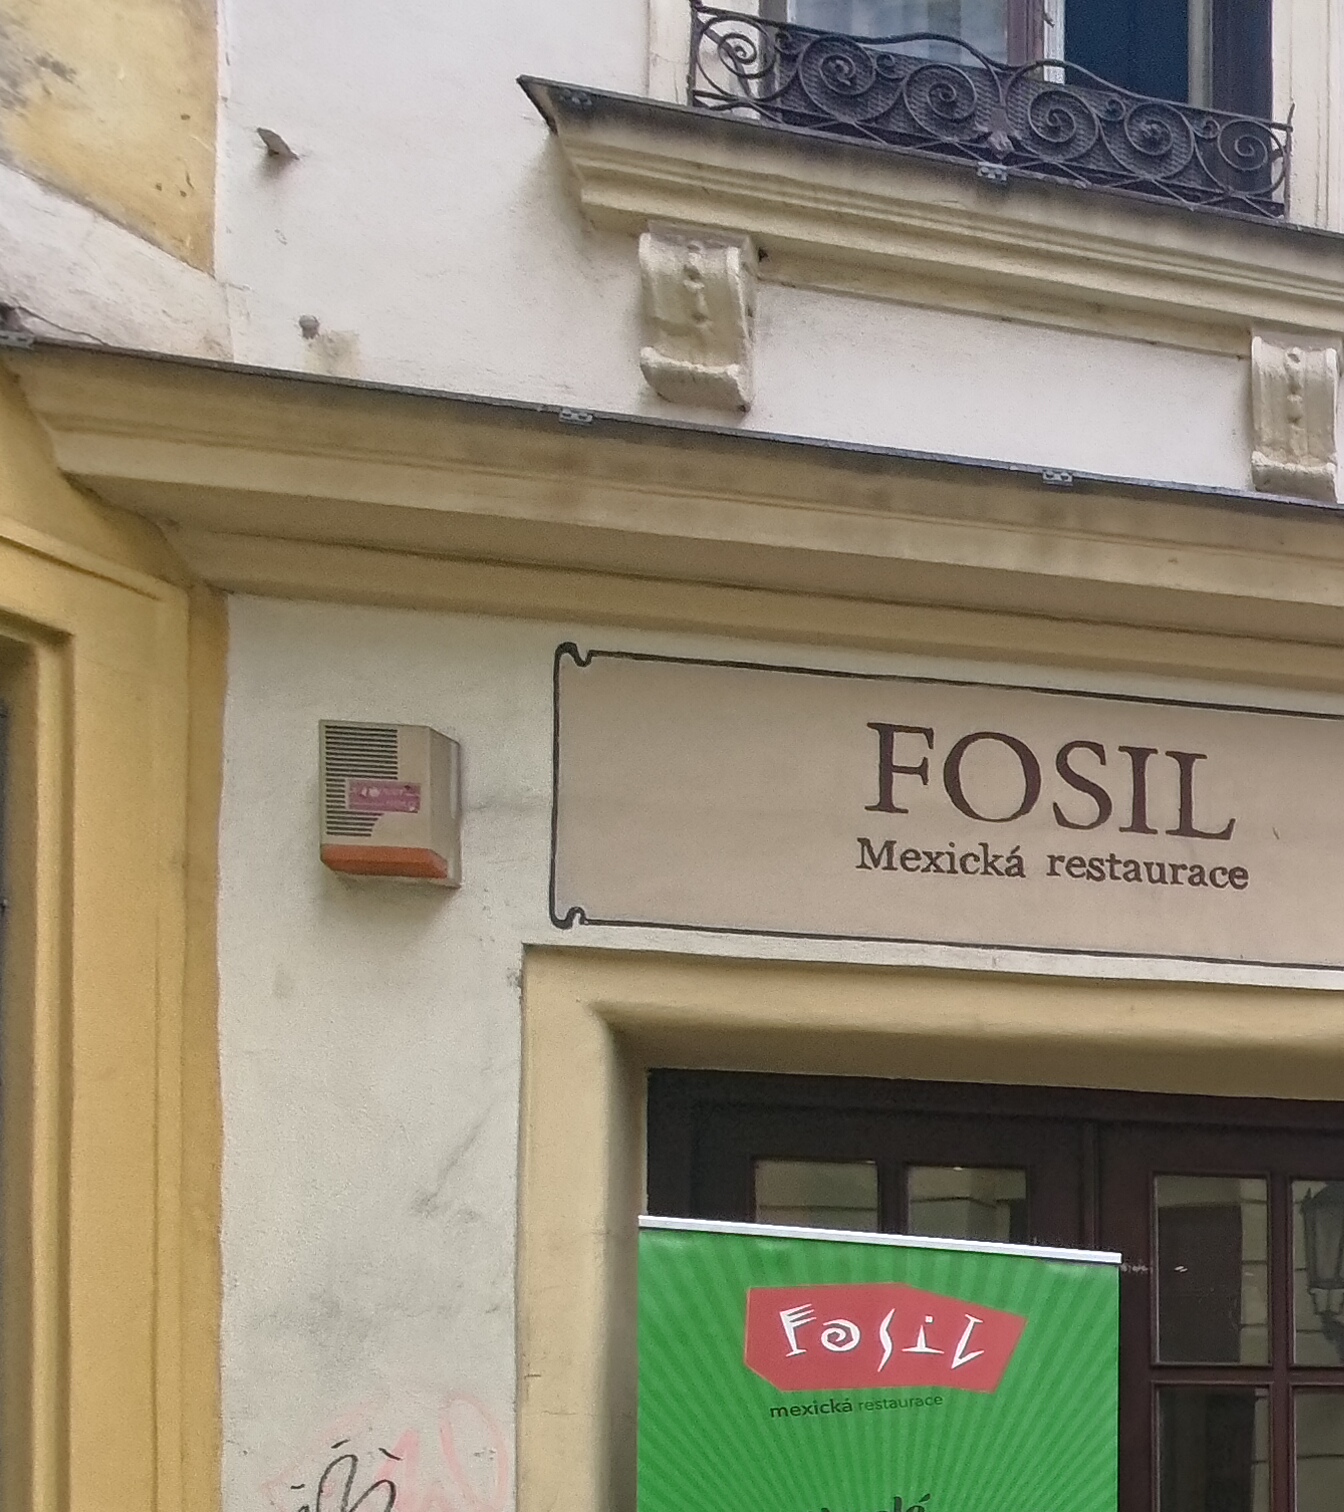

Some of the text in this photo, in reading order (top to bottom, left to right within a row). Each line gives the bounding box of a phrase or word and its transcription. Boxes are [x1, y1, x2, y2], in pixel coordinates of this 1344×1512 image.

[865, 722, 1236, 840] FOSIL
[856, 837, 1249, 889] Mexická restaurace
[770, 1394, 943, 1418] mexická restaurace
